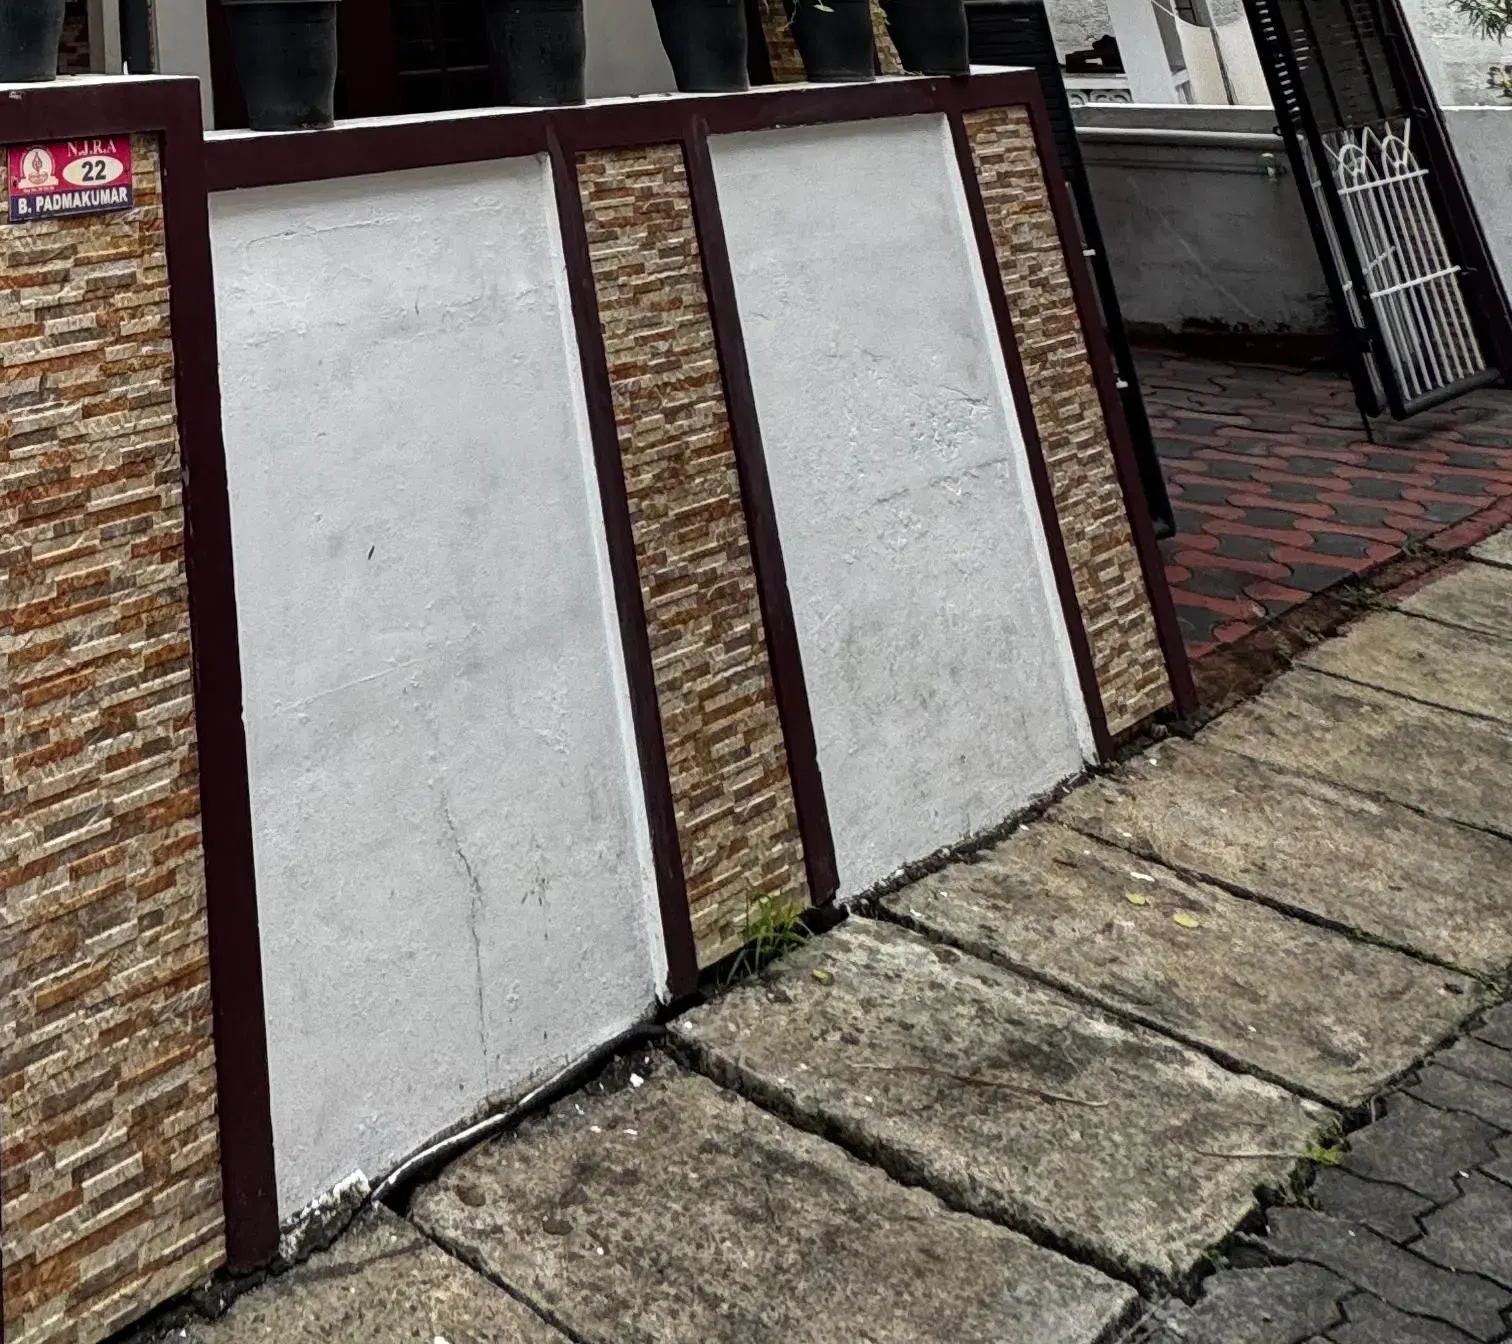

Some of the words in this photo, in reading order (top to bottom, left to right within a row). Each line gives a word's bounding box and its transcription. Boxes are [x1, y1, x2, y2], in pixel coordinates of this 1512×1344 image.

[81, 160, 106, 181] 22
[18, 198, 32, 214] B.
[36, 187, 128, 213] PADMAKUMAR
